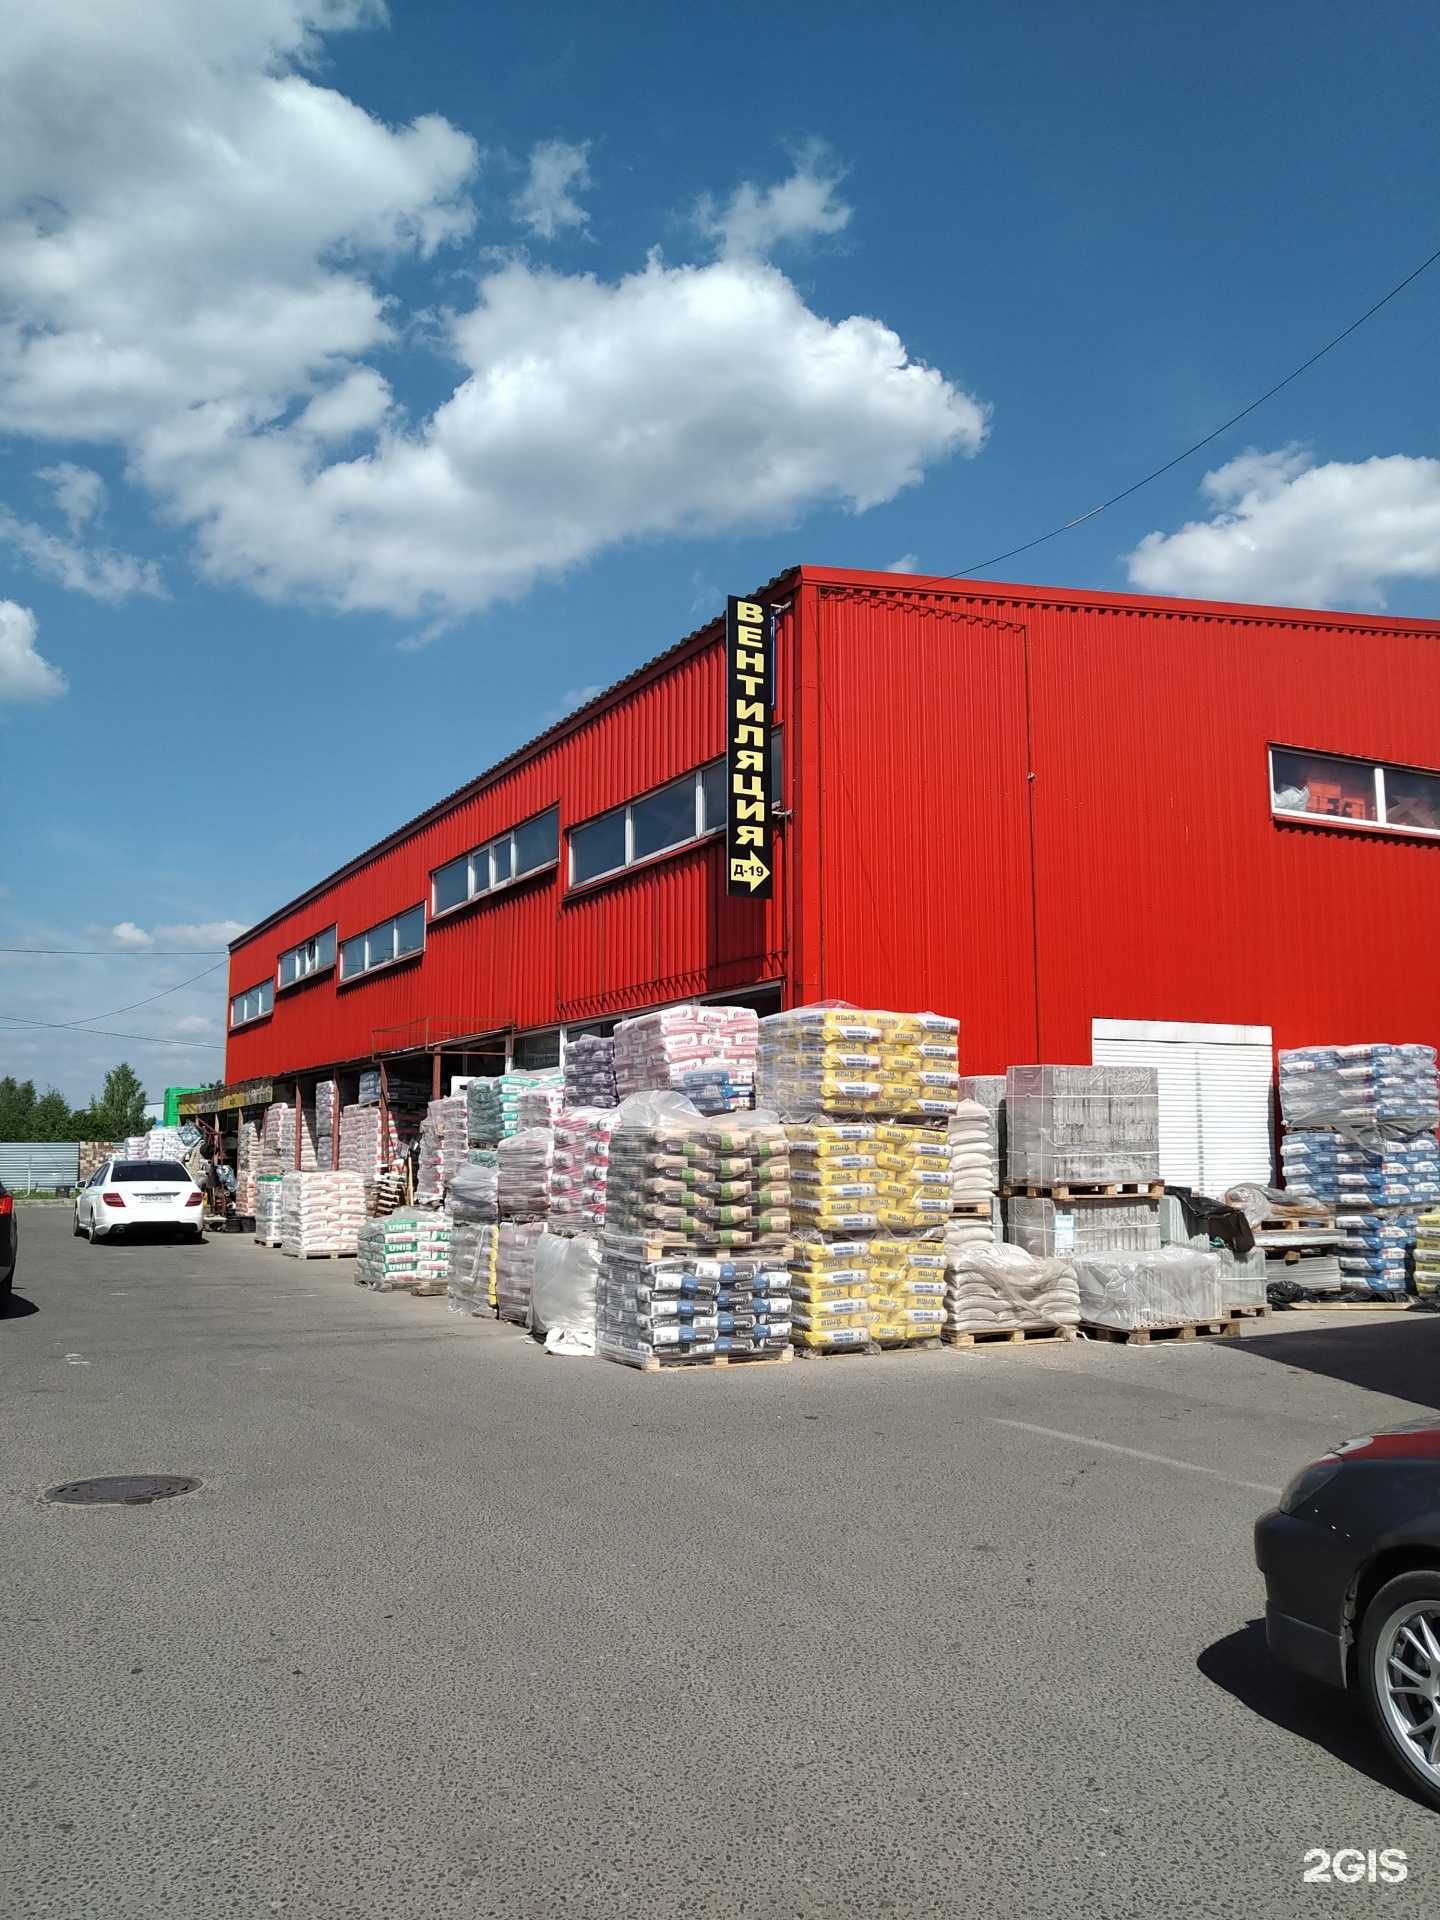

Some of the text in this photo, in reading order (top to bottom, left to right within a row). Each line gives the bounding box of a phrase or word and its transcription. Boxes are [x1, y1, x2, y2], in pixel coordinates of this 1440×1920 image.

[733, 600, 765, 847] ВЕНТИЛЯЦИЯ
[734, 864, 764, 877] Д-19
[388, 1243, 412, 1252] UNIS
